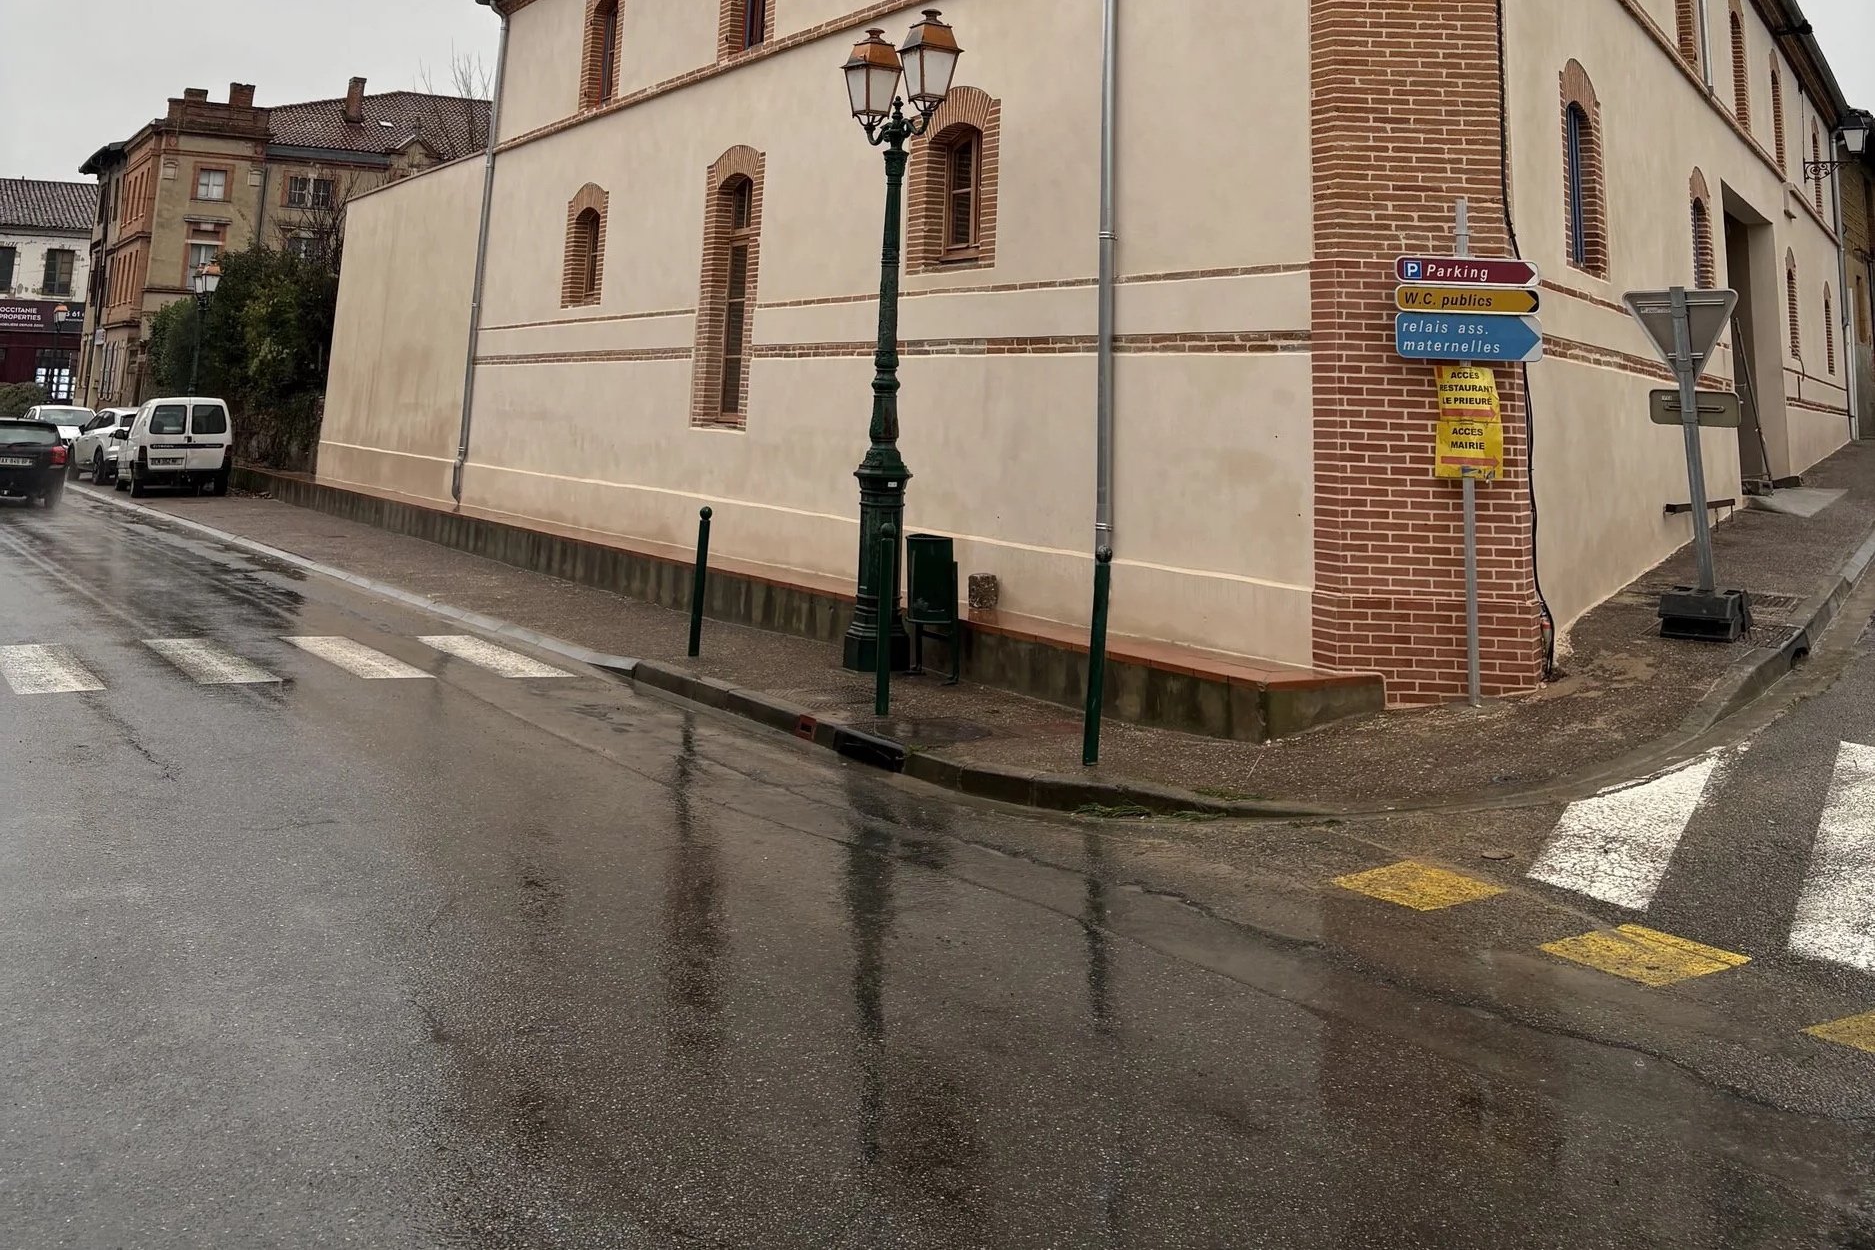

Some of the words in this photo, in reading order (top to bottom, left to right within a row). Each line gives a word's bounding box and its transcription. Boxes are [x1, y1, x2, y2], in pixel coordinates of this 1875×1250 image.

[1407, 263, 1418, 277] P
[1426, 264, 1488, 281] Parking
[1405, 292, 1436, 305] W.C.
[1441, 294, 1492, 308] publics
[0, 306, 38, 314] OCCITANIE
[0, 313, 42, 321] PROPERTIES
[1402, 320, 1448, 333] relais
[1458, 324, 1488, 335] ass.
[1403, 340, 1500, 353] maternelles
[1440, 384, 1493, 393] RESTAURANT
[1442, 397, 1452, 405] LE
[1450, 441, 1485, 450] MAIRIE
